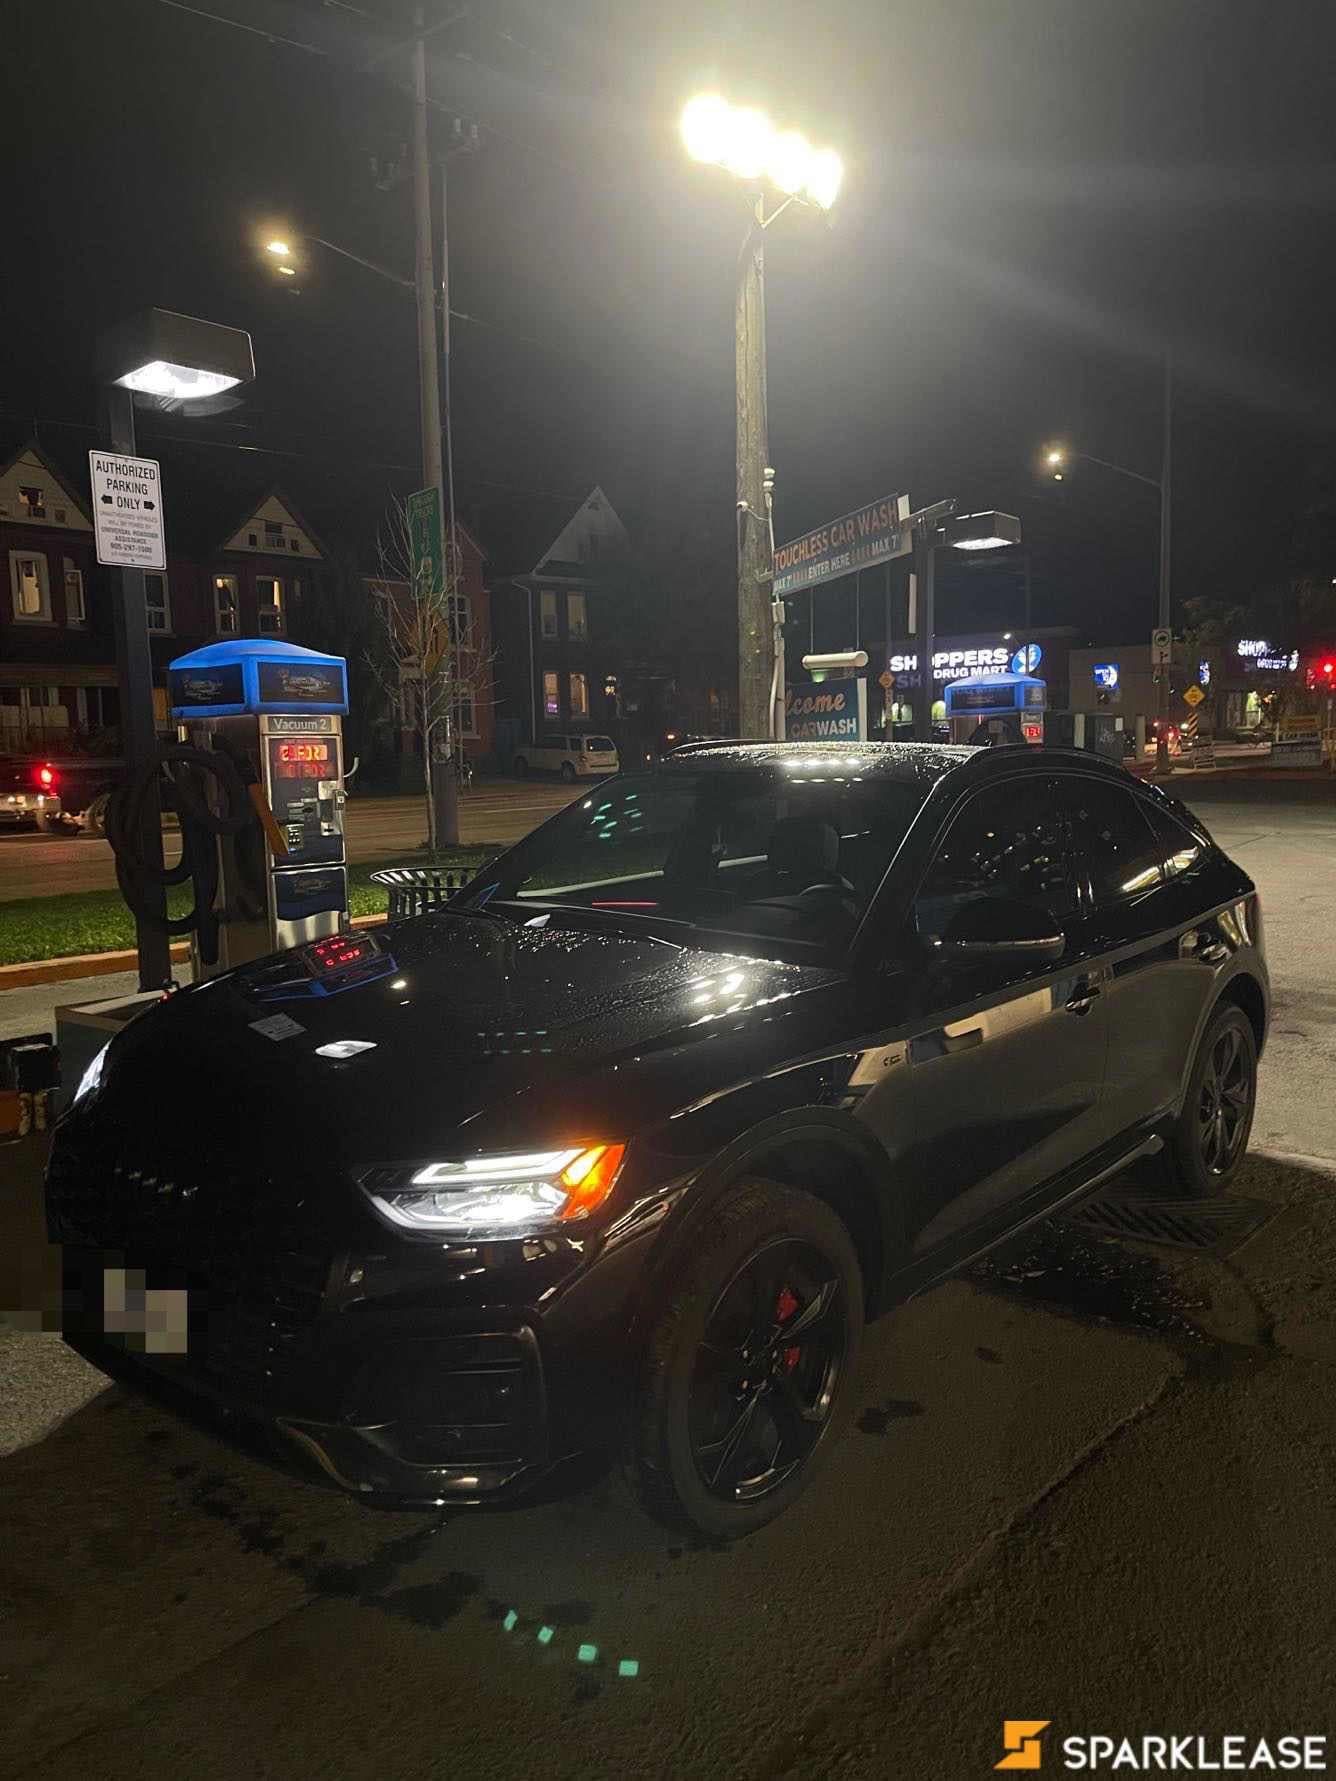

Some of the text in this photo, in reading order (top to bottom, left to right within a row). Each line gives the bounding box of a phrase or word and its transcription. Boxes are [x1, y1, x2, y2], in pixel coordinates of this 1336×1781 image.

[96, 460, 156, 480] AUTHORIZED
[106, 478, 148, 495] PARKING
[116, 496, 141, 510] ONLY
[773, 499, 898, 575] TOUCHLESS CAR WASH
[808, 561, 830, 580] ENTER
[831, 552, 850, 571] HERE
[871, 537, 889, 556] MAX
[889, 648, 1009, 672] SHPPERS
[933, 664, 1008, 679] DRUG MART
[785, 688, 846, 716] lcome
[273, 718, 328, 730] Vacuum 2
